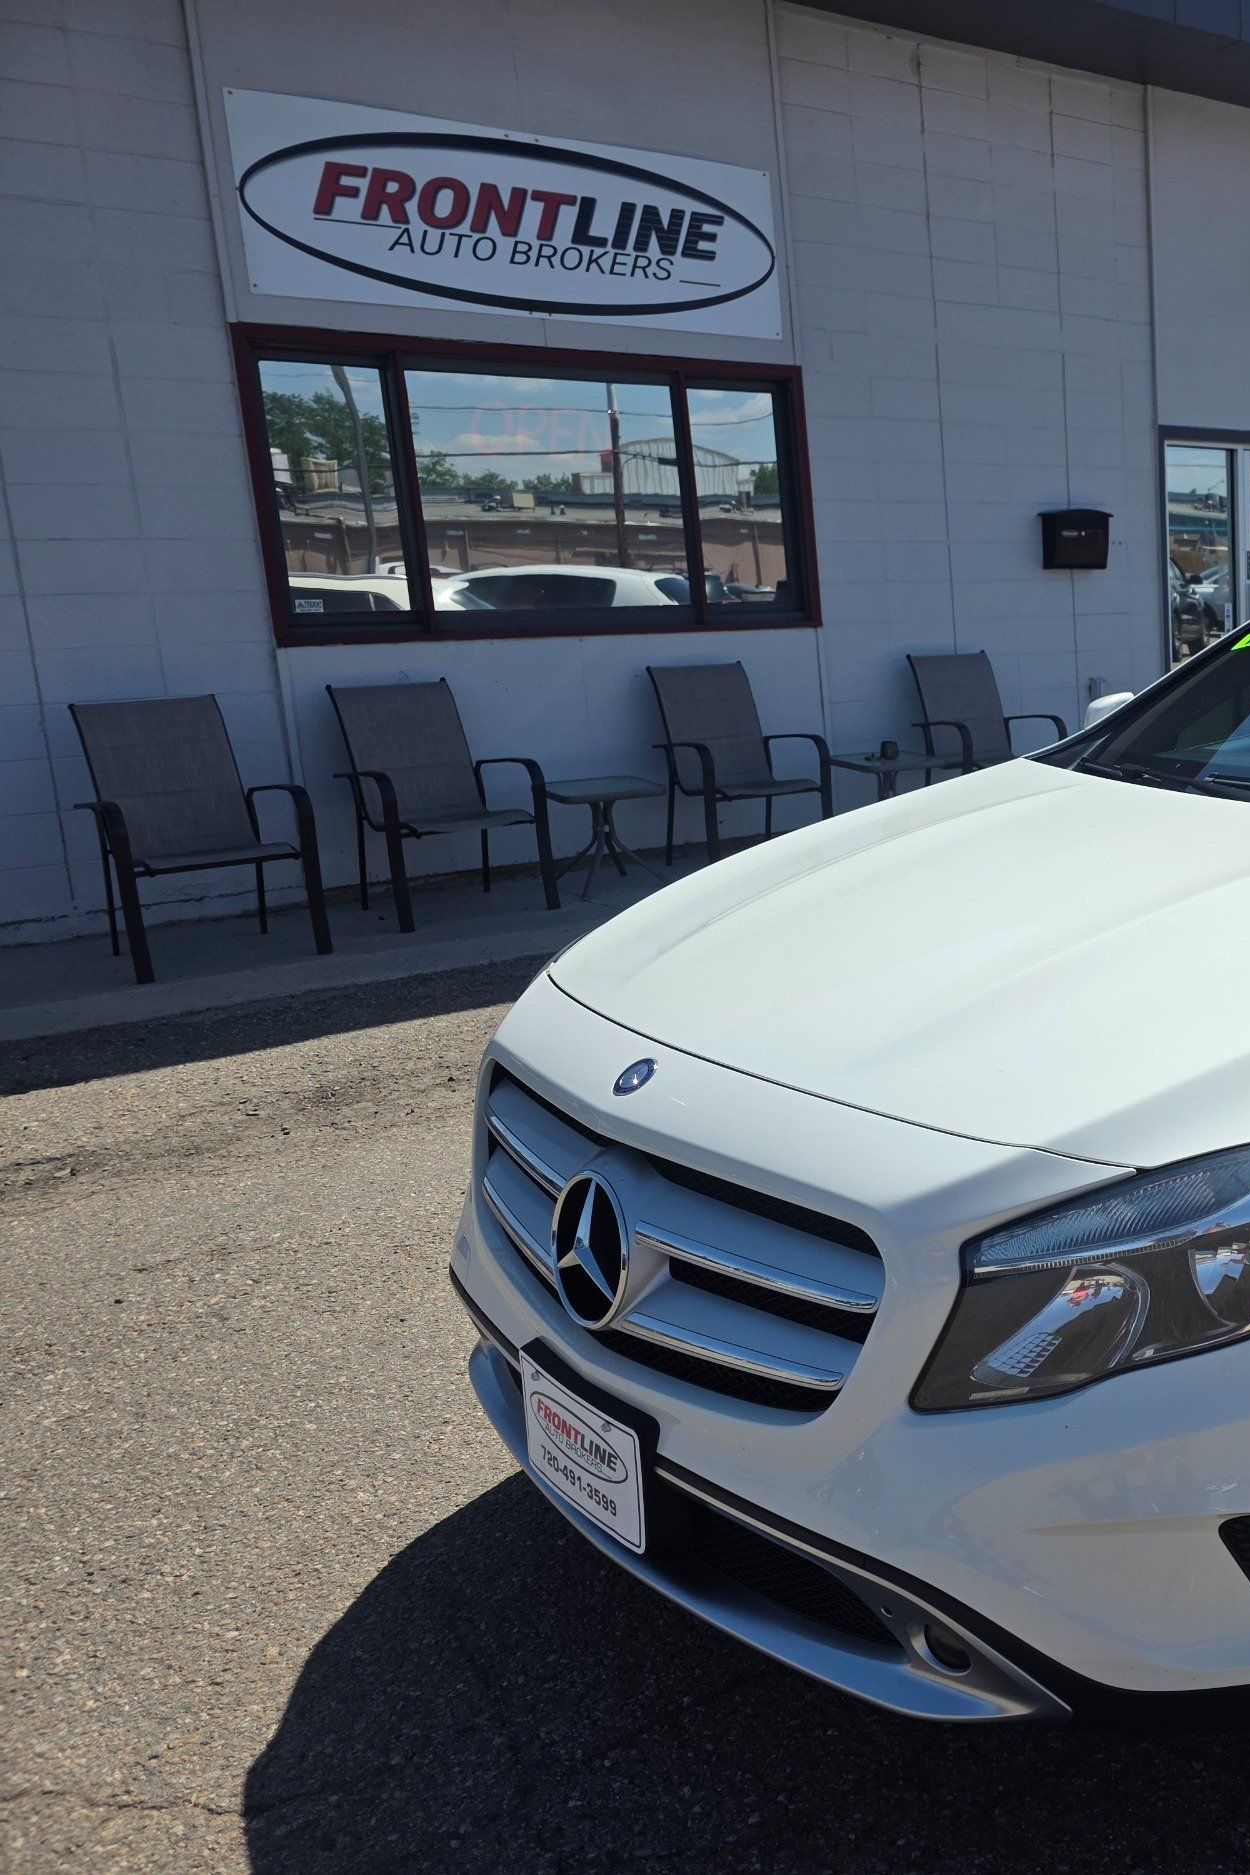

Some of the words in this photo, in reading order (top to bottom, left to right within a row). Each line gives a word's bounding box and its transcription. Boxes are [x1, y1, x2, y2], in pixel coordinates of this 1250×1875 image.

[313, 161, 725, 261] FRONTLINE
[388, 227, 497, 262] AUTO
[509, 239, 674, 282] BROKERS
[471, 400, 613, 460] OPEN
[537, 1397, 618, 1473] FRONTLINE
[545, 1423, 564, 1444] AUTO
[565, 1440, 603, 1473] BROKERS
[541, 1444, 617, 1517] 720-491-3599
